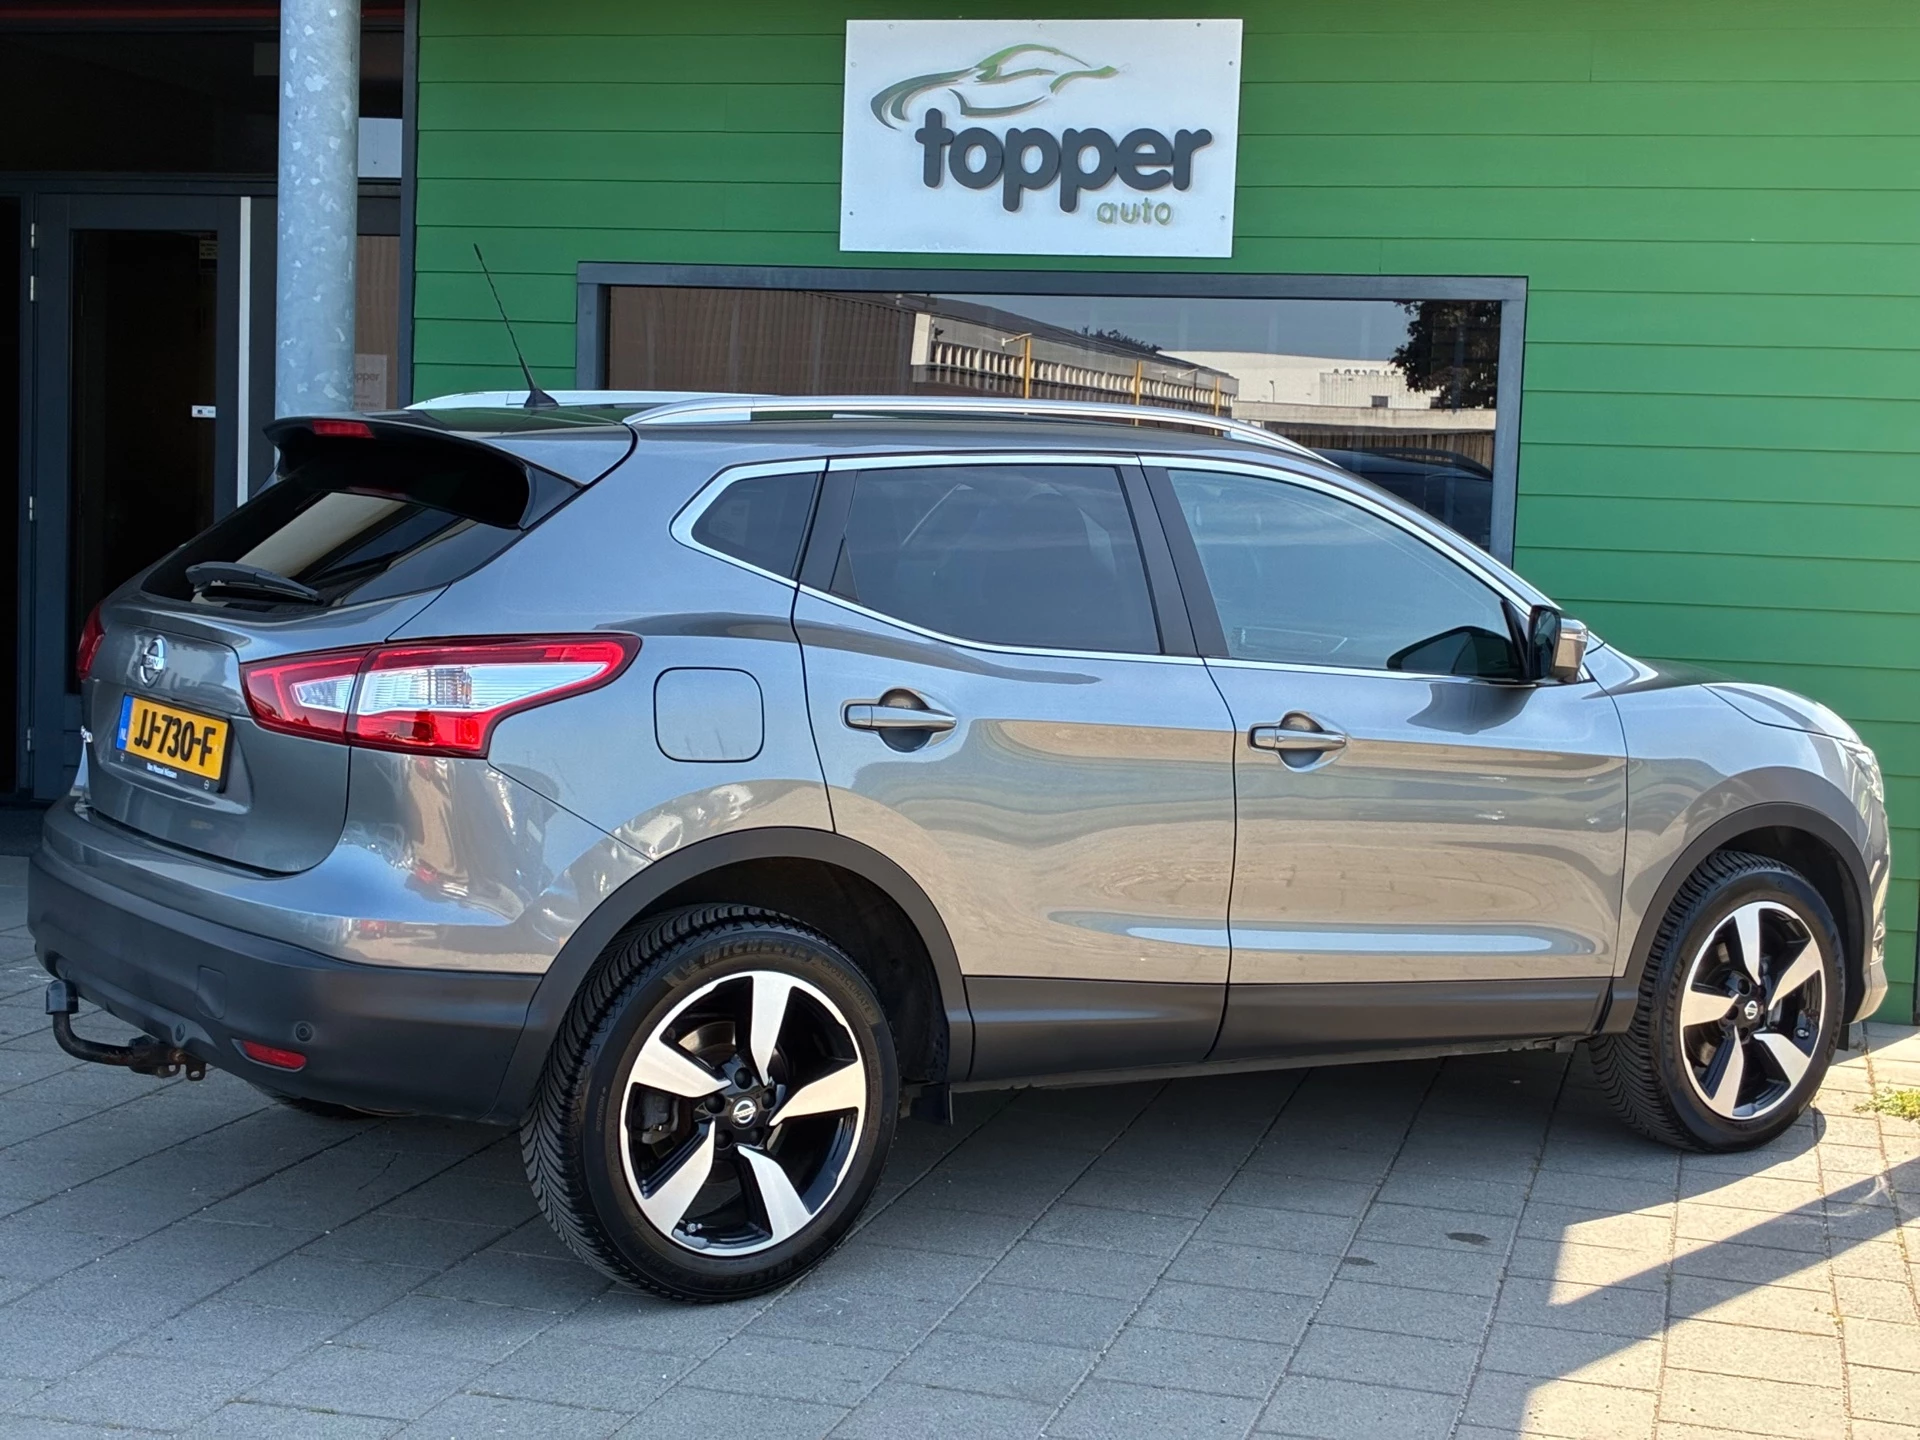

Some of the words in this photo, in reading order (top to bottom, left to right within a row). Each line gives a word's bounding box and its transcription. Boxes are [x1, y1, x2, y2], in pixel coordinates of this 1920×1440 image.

[915, 108, 1212, 212] topper
[1097, 197, 1172, 225] auto
[134, 708, 216, 767] JJ-730-F
